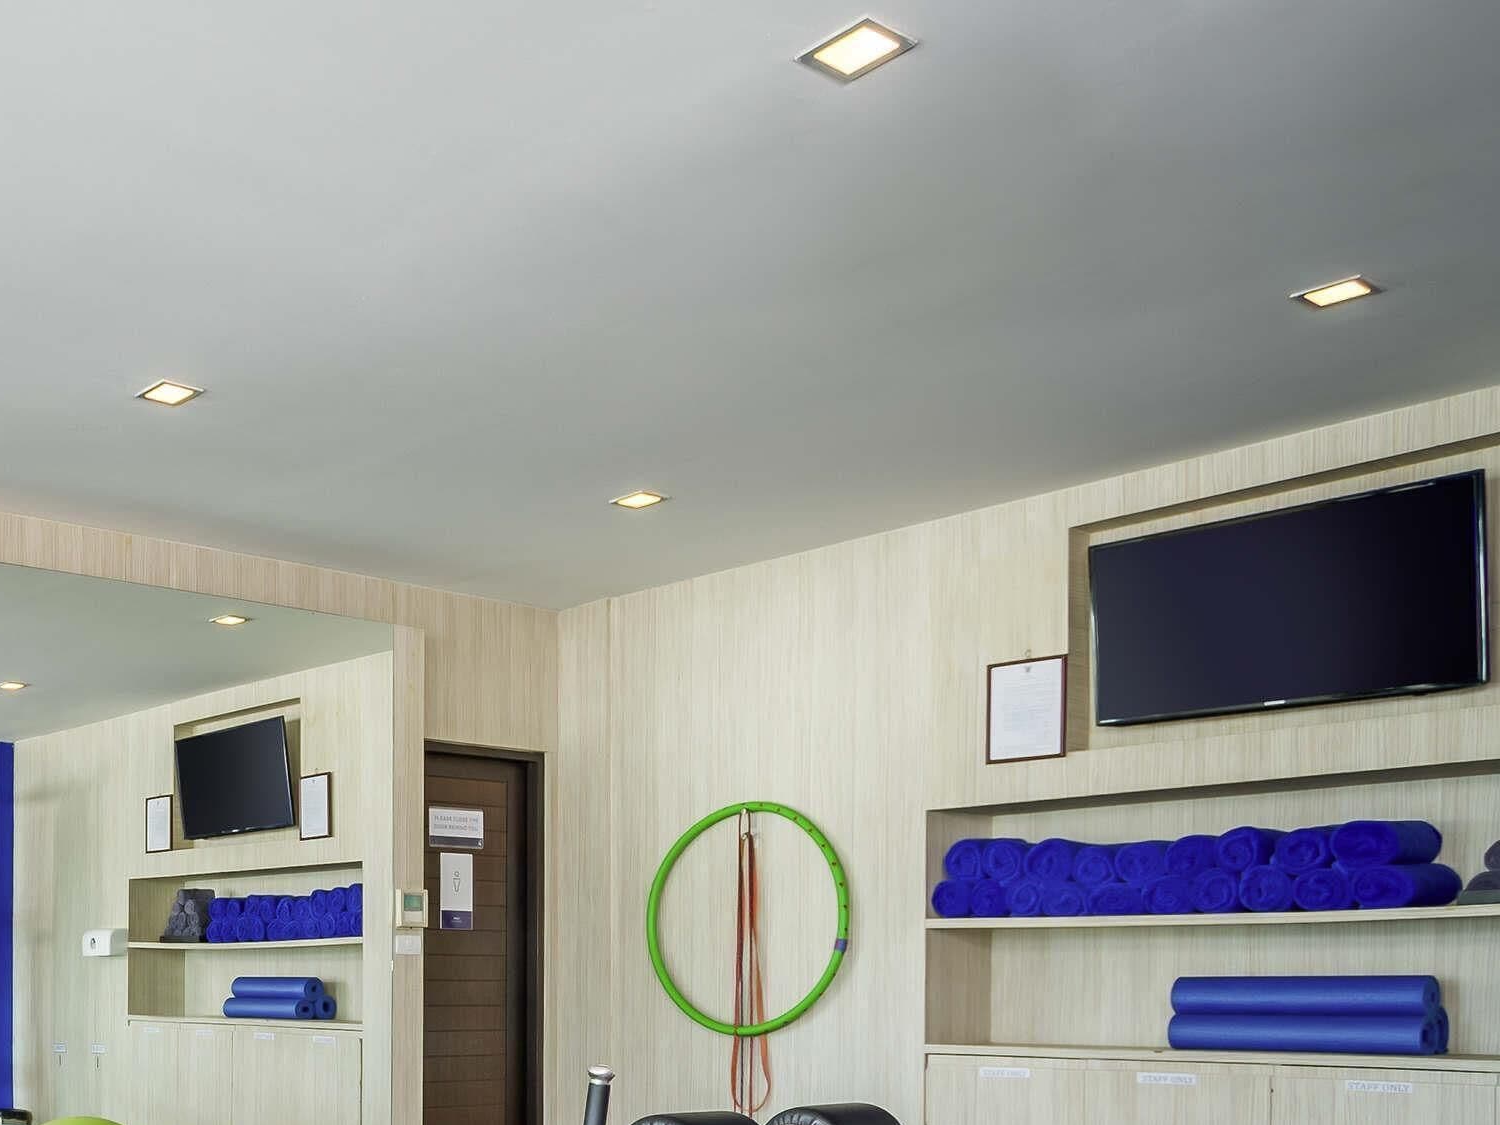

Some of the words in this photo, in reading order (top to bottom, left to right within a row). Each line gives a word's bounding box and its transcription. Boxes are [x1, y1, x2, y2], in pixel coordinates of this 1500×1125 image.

[1142, 1074, 1169, 1083] STAFF
[1348, 1081, 1380, 1091] STAFF
[1382, 1082, 1410, 1093] ONLY
